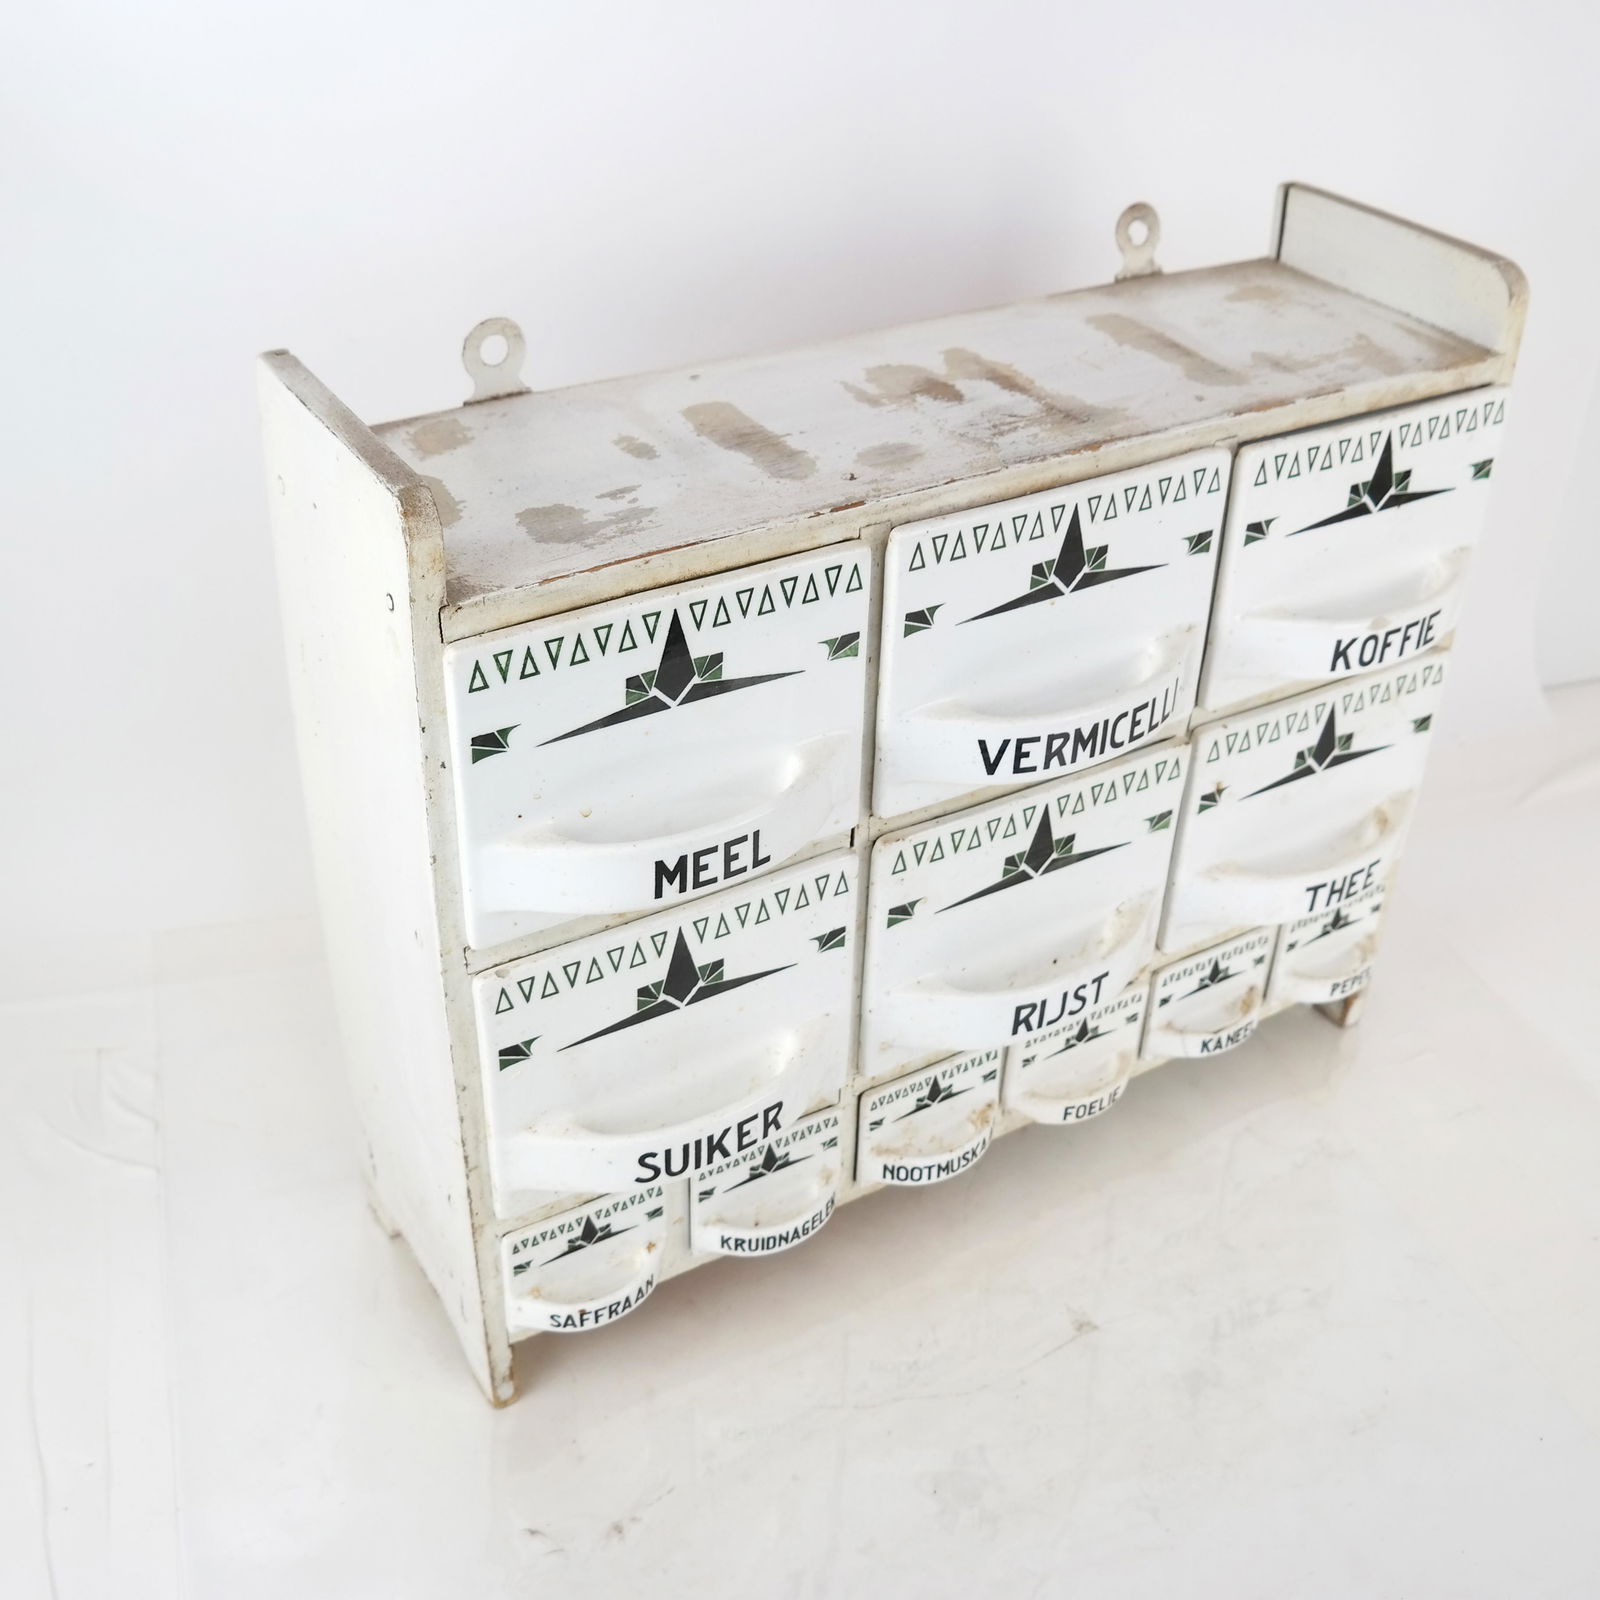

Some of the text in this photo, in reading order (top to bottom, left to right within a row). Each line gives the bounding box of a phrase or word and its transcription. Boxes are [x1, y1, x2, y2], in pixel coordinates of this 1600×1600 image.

[1330, 608, 1441, 671] KOFFIE
[977, 676, 1179, 776] VERMICELLI
[654, 829, 771, 899] MEEL
[1306, 857, 1381, 912] THEE
[1011, 970, 1109, 1036] RIJST
[634, 1100, 783, 1183] SUIKER
[550, 1273, 654, 1328] SAFFRAAN
